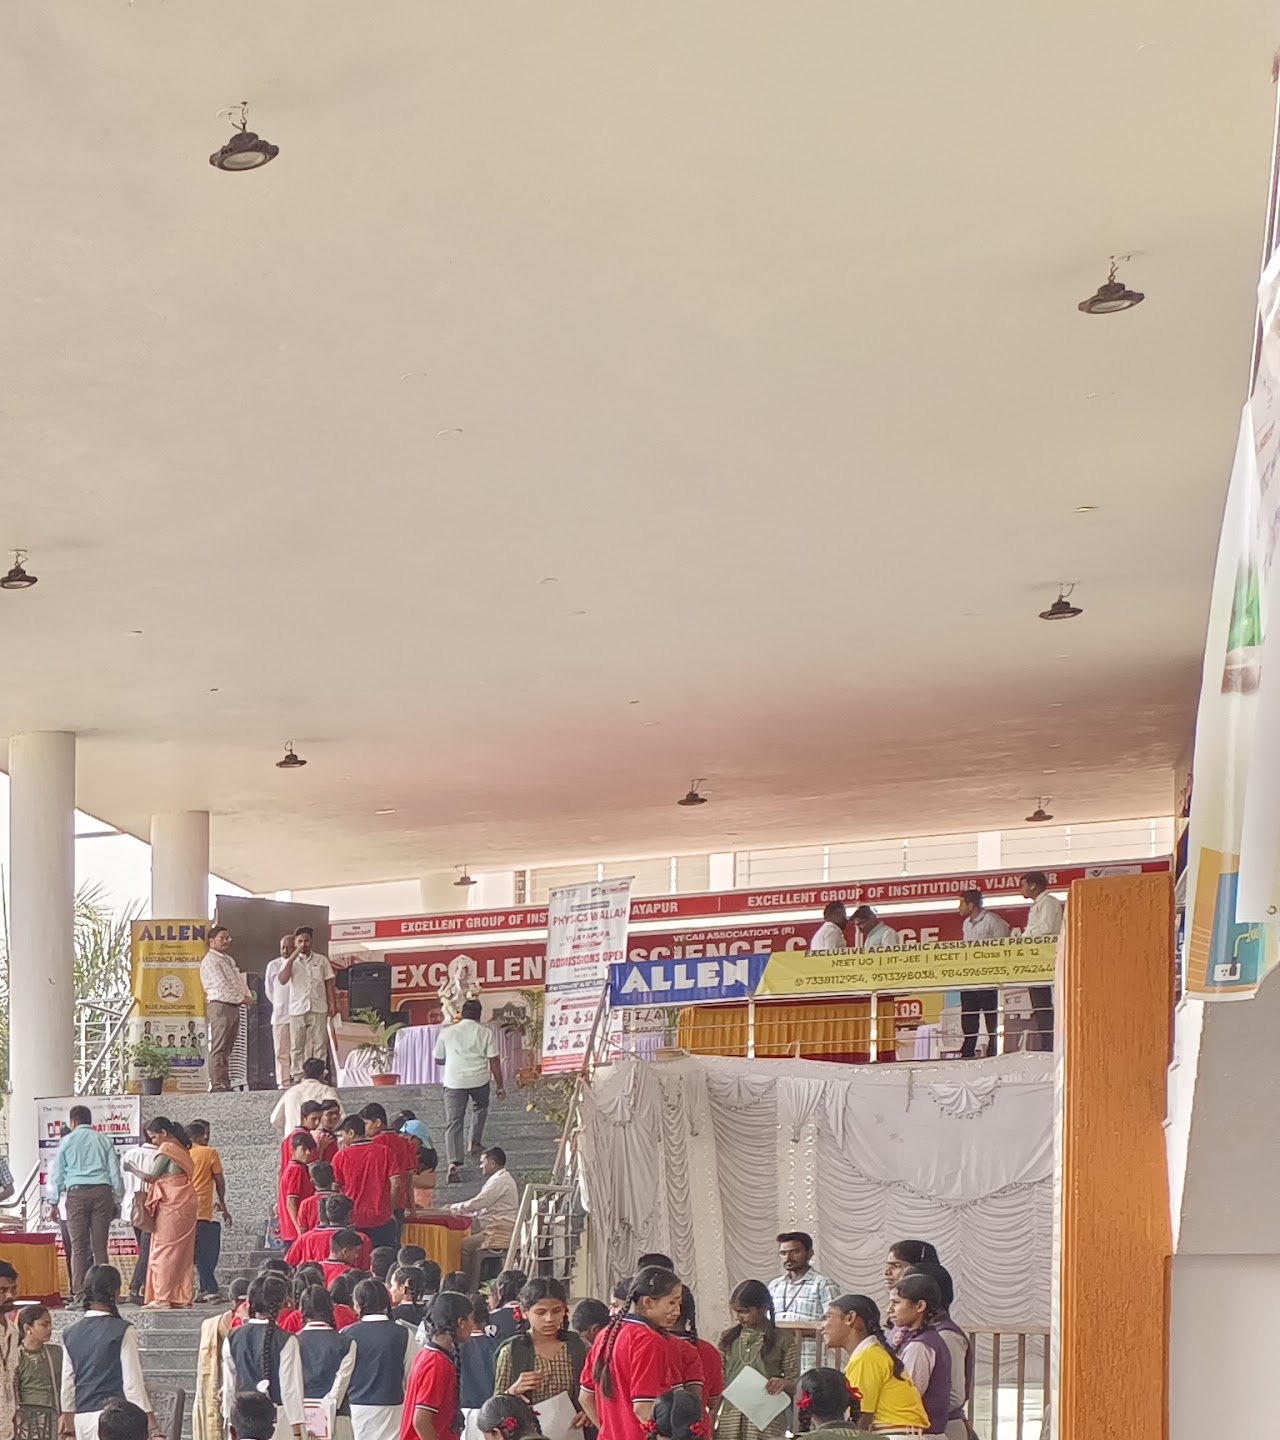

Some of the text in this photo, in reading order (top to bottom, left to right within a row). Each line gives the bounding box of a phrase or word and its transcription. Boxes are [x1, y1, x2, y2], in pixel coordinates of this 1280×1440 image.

[748, 891, 817, 907] EXCELLENT
[820, 887, 864, 902] GROUP
[868, 885, 884, 899] OF
[888, 879, 981, 897] INSTITUTIONS,
[591, 908, 627, 921] WALLAH
[632, 901, 679, 916] AYAPUR
[401, 917, 464, 933] EXCELLENT
[466, 915, 505, 929] GROUP
[508, 914, 524, 925] OF
[781, 926, 795, 936] (R)
[139, 925, 206, 941] ALLEN
[804, 947, 865, 957] EXCLUSIVE
[868, 943, 930, 955] ACADEMIC
[933, 938, 1006, 950] ASSISTANCE
[550, 950, 624, 968] ADMISSIONS OPEN
[831, 959, 856, 968] NEET
[858, 958, 874, 966] UG
[887, 954, 920, 964] IIT-JEE
[933, 952, 960, 961] KCET
[973, 951, 1001, 959] Class
[1003, 949, 1012, 957] 11
[1029, 948, 1040, 956] 12
[619, 959, 749, 994] ALLEN
